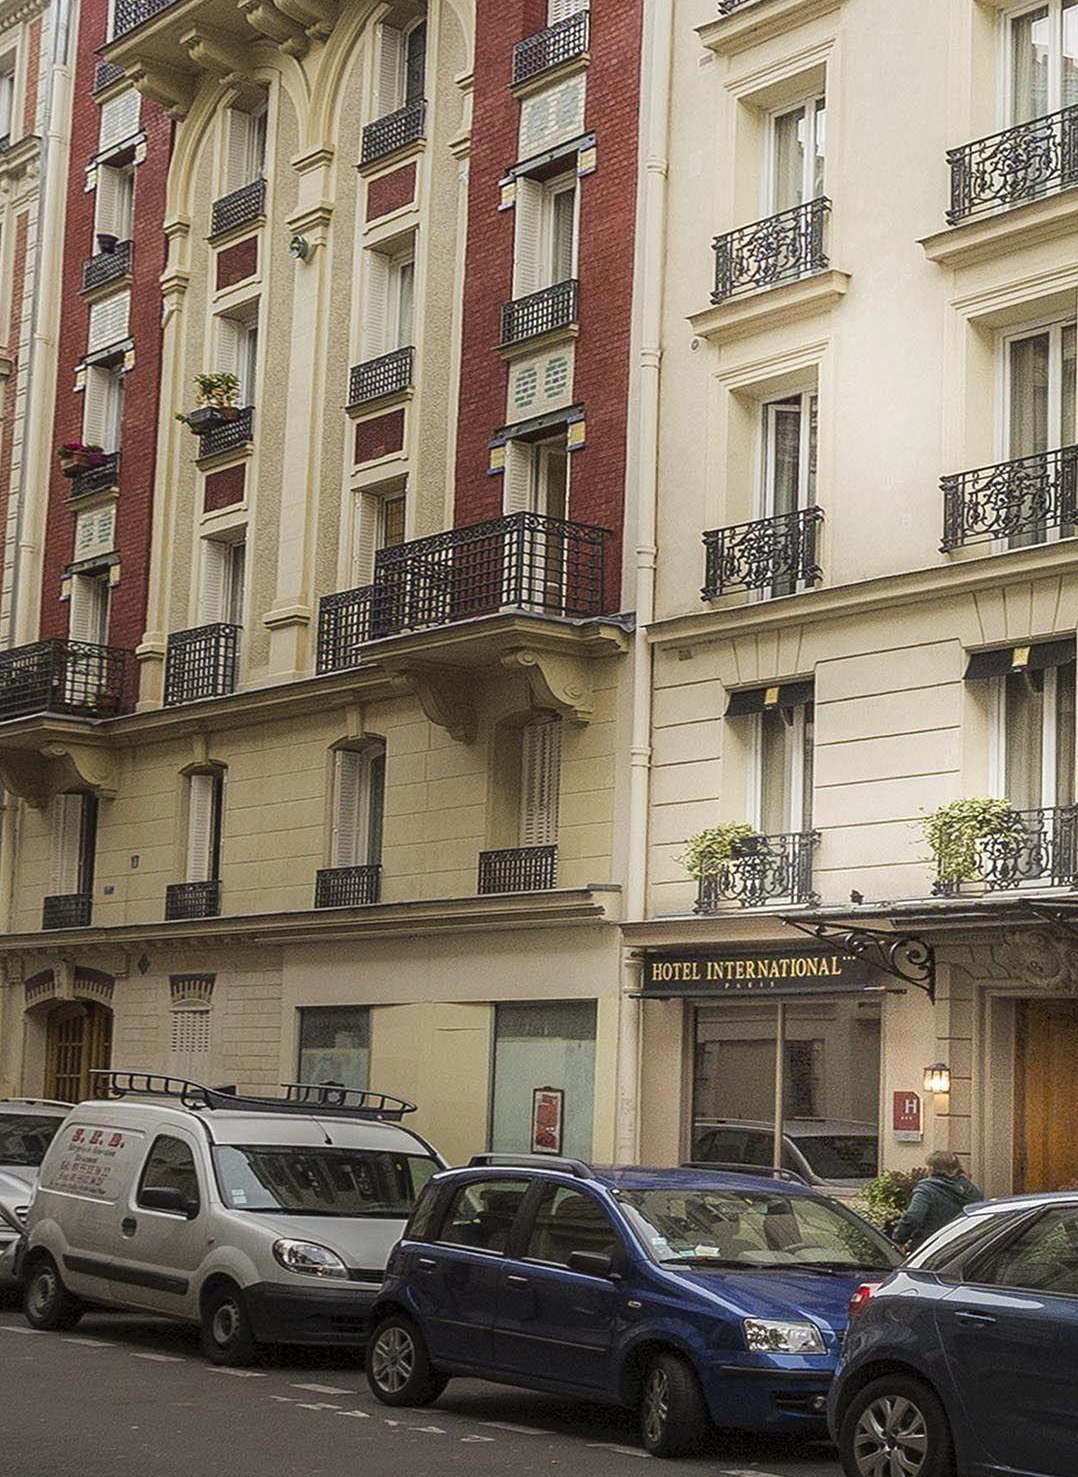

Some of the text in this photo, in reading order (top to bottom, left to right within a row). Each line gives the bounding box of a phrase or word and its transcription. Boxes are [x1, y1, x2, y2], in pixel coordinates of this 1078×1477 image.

[652, 955, 842, 981] HOTEL INTERNATIONAL
[905, 1099, 917, 1114] H
